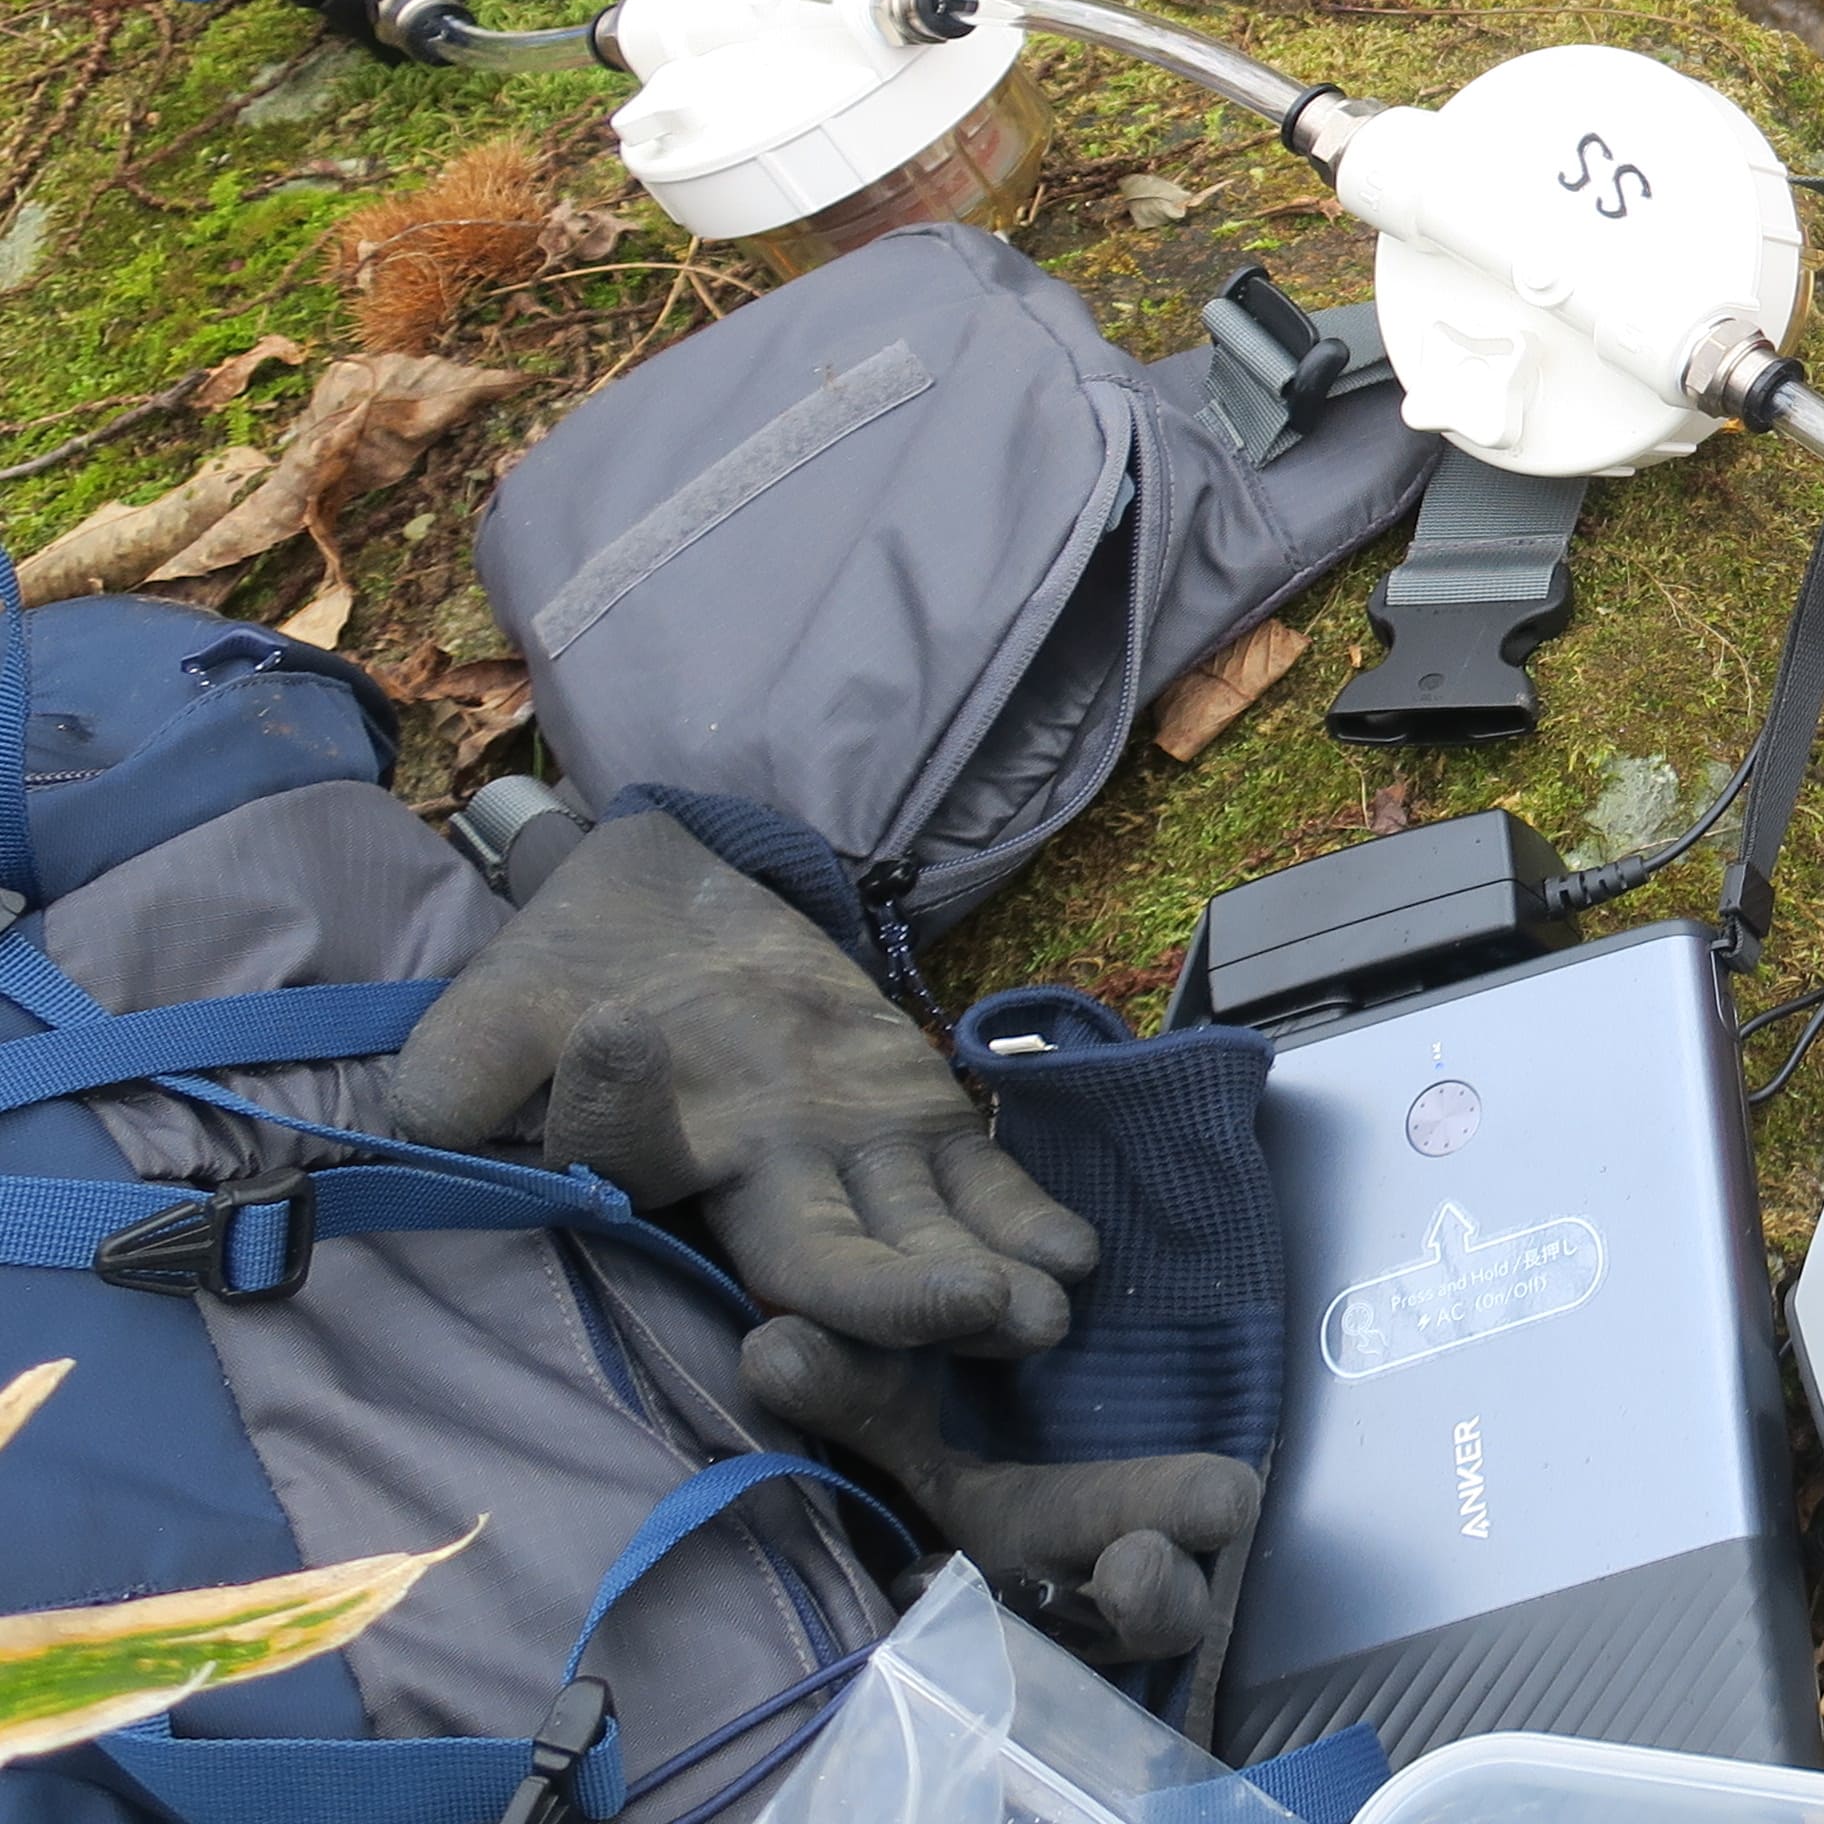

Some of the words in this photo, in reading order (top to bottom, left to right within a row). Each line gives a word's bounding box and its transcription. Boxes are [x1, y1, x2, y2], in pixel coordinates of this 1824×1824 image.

[1558, 132, 1652, 219] SS
[1391, 1287, 1435, 1313] Press
[1437, 1277, 1467, 1297] and
[1471, 1261, 1509, 1285] Hold
[1436, 1303, 1465, 1327] AC
[1454, 1415, 1491, 1538] ANKER
